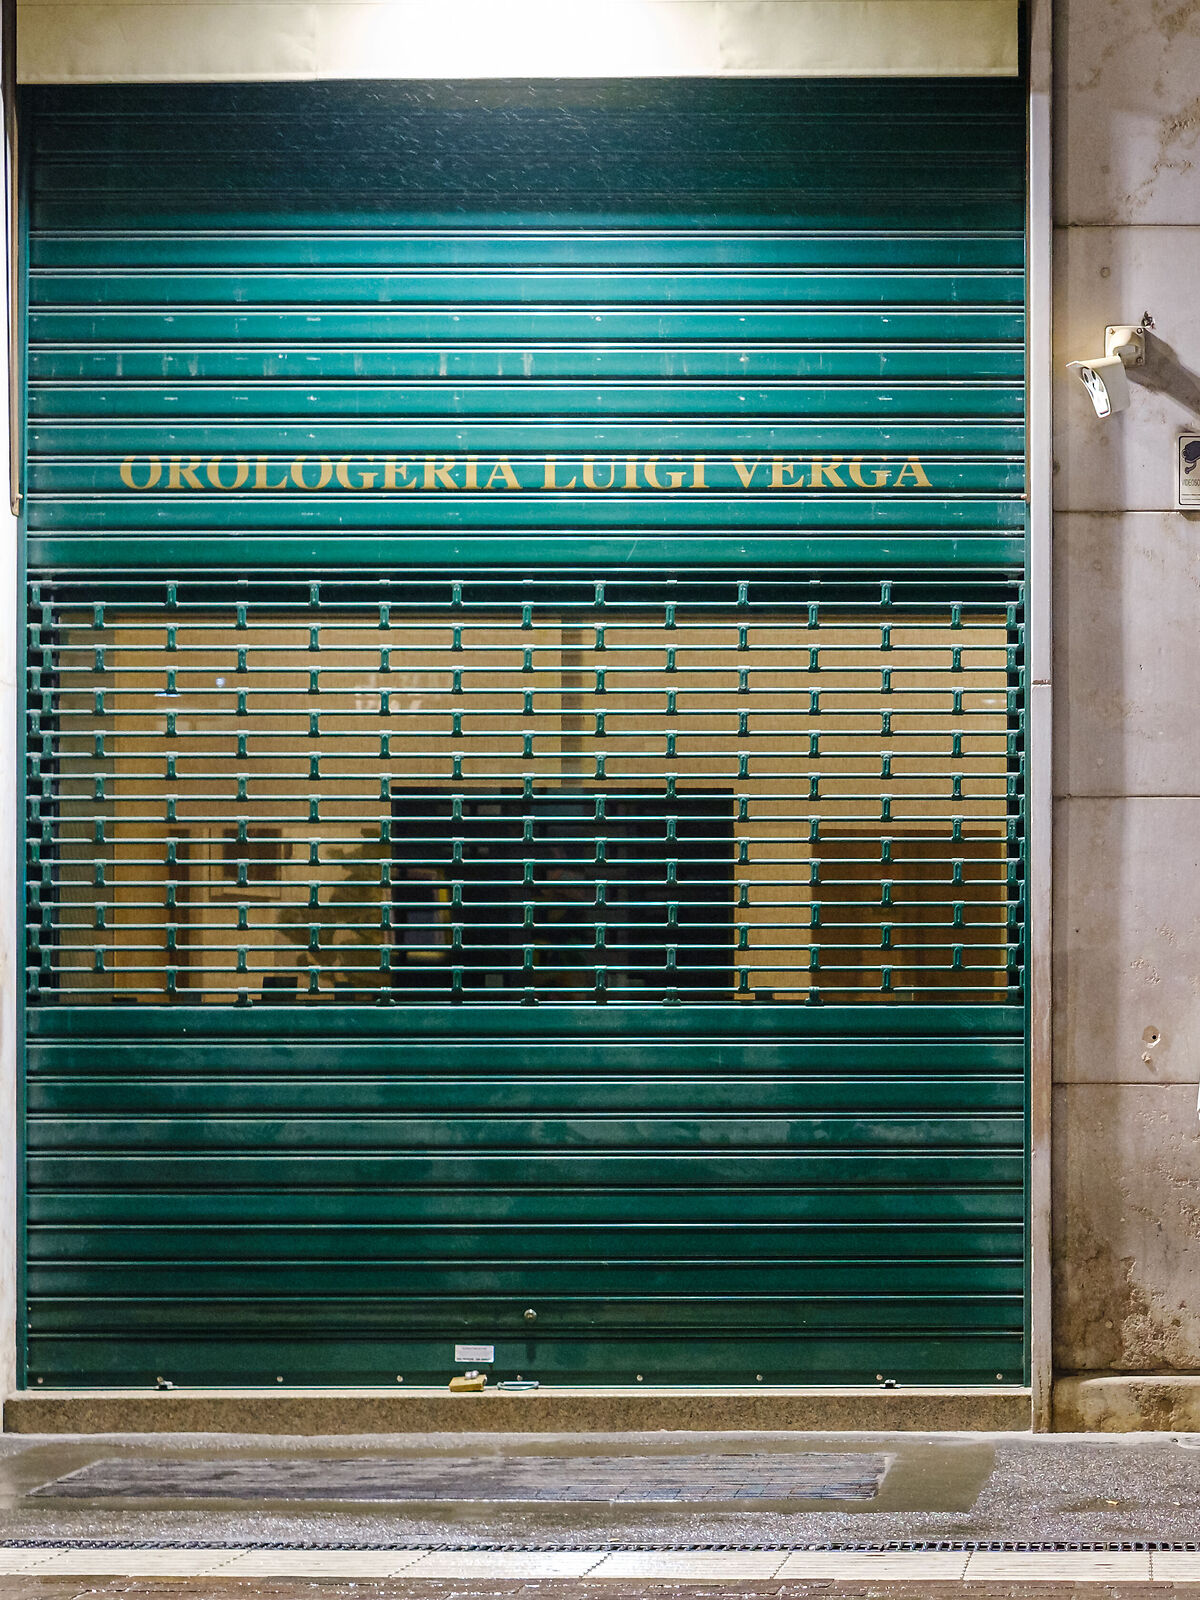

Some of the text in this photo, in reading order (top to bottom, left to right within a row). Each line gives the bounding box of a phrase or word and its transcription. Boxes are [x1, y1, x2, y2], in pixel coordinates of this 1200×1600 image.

[119, 455, 934, 490] OROLOGERIA LUIGI VERGA
